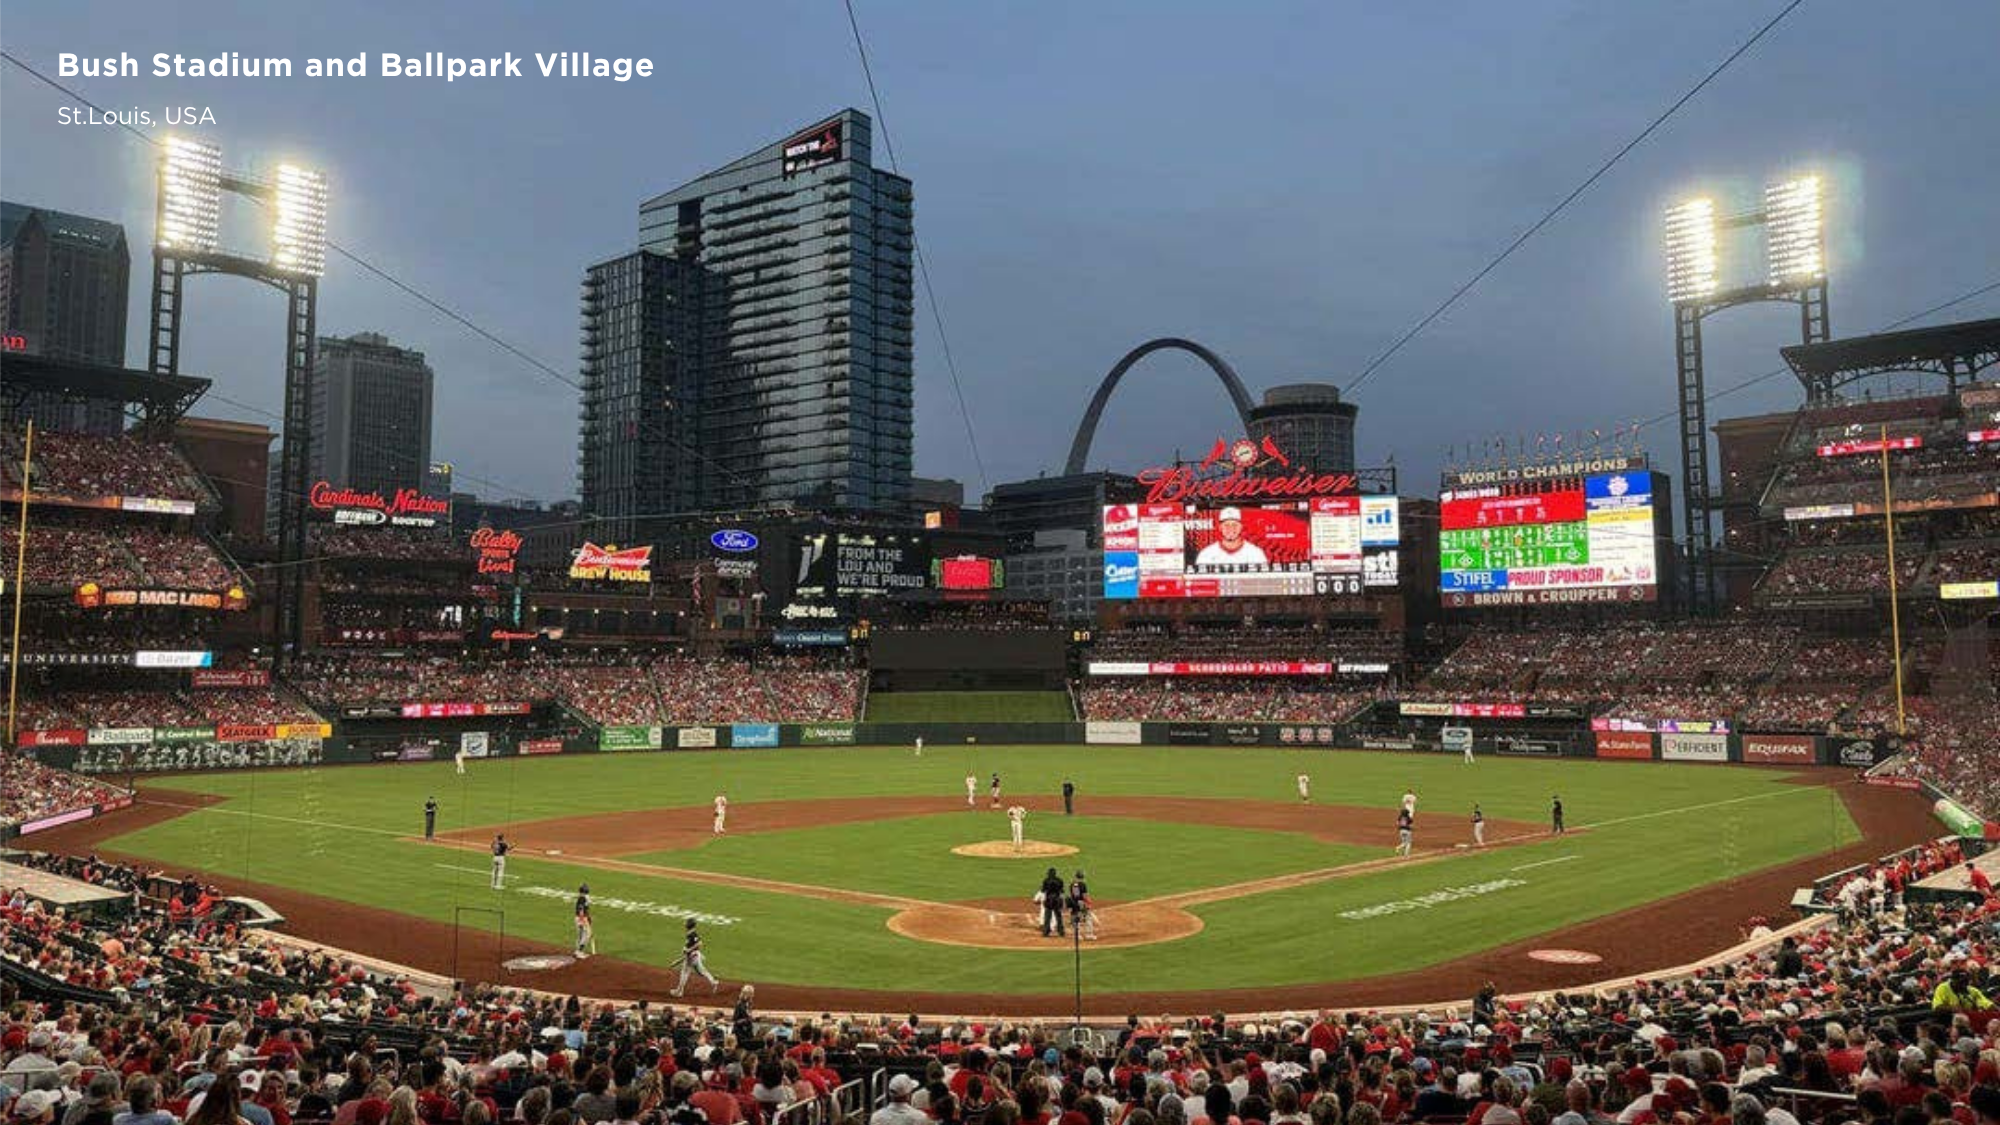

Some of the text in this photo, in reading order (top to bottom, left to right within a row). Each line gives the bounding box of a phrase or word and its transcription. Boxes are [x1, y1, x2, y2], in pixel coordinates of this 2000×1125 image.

[1459, 459, 1627, 484] WORLD CHAMPIONS
[1138, 464, 1356, 503] Budweiser
[310, 481, 448, 515] Cardinals Nation
[470, 528, 524, 554] Bally
[721, 531, 749, 548] Ford
[837, 548, 902, 562] FROM THE
[837, 560, 893, 573] LOU AND
[570, 566, 650, 582] BREW HOUSE
[837, 573, 924, 588] WE'RE PROUD
[1453, 570, 1496, 587] STIFEL
[1508, 567, 1604, 586] PROUD SPONSOR
[1317, 580, 1359, 594] 0 0 0
[139, 591, 178, 605] MAC
[1474, 588, 1618, 605] BROWN & CROUPPEN
[23, 653, 131, 664] UNIVERSITY
[1188, 663, 1254, 673] SCOREBOARD
[1259, 663, 1288, 673] PATIO
[103, 729, 153, 742] Ballpark
[221, 728, 270, 740] SEATGEEK
[815, 728, 852, 738] National
[1748, 743, 1807, 756] EQUIFAX
